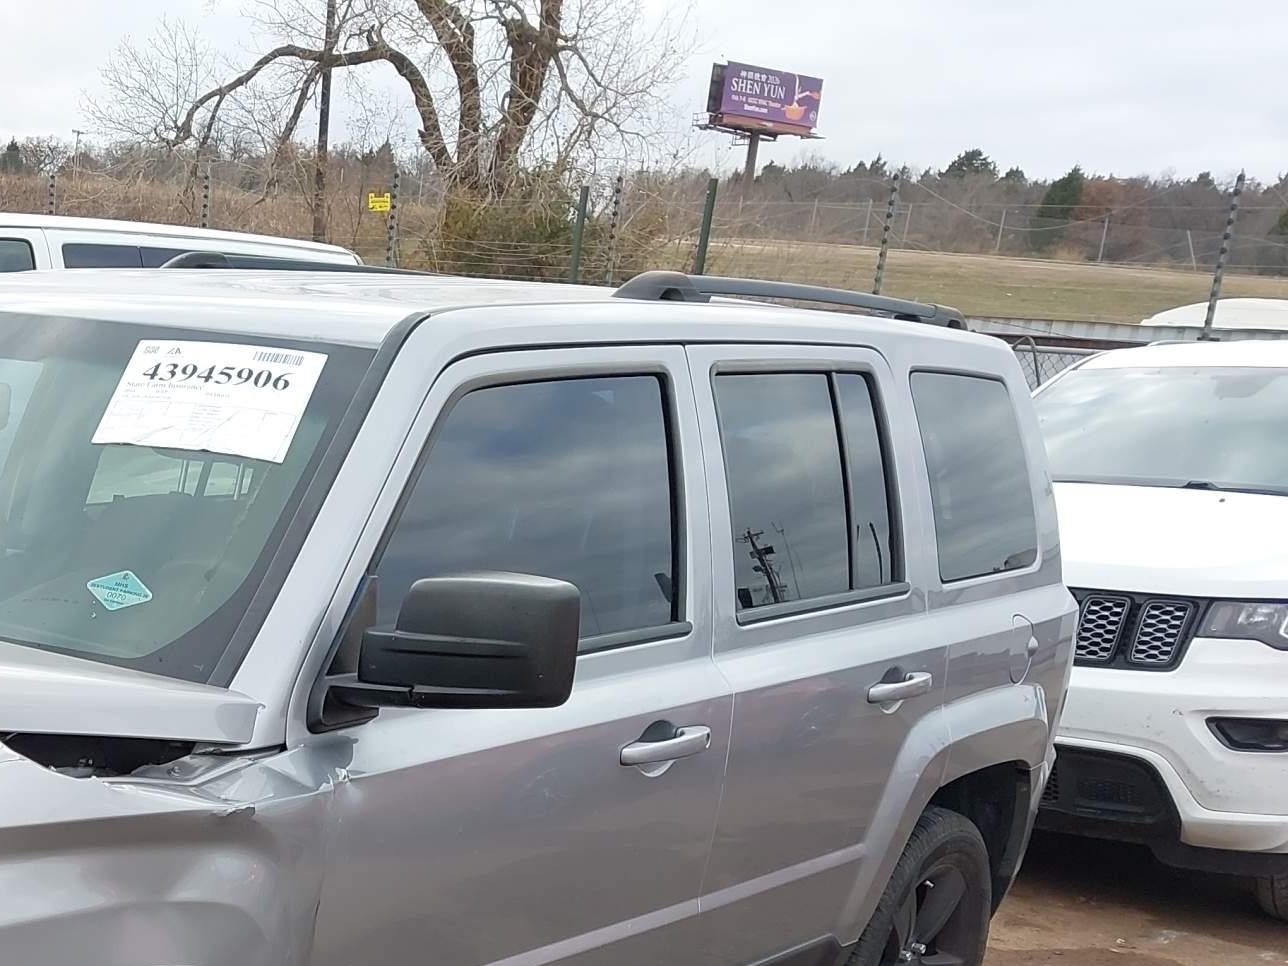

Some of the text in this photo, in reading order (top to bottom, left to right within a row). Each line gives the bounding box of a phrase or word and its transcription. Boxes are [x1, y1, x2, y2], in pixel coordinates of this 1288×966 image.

[731, 78, 786, 99] SHEN YUN
[142, 361, 296, 391] 43945906
